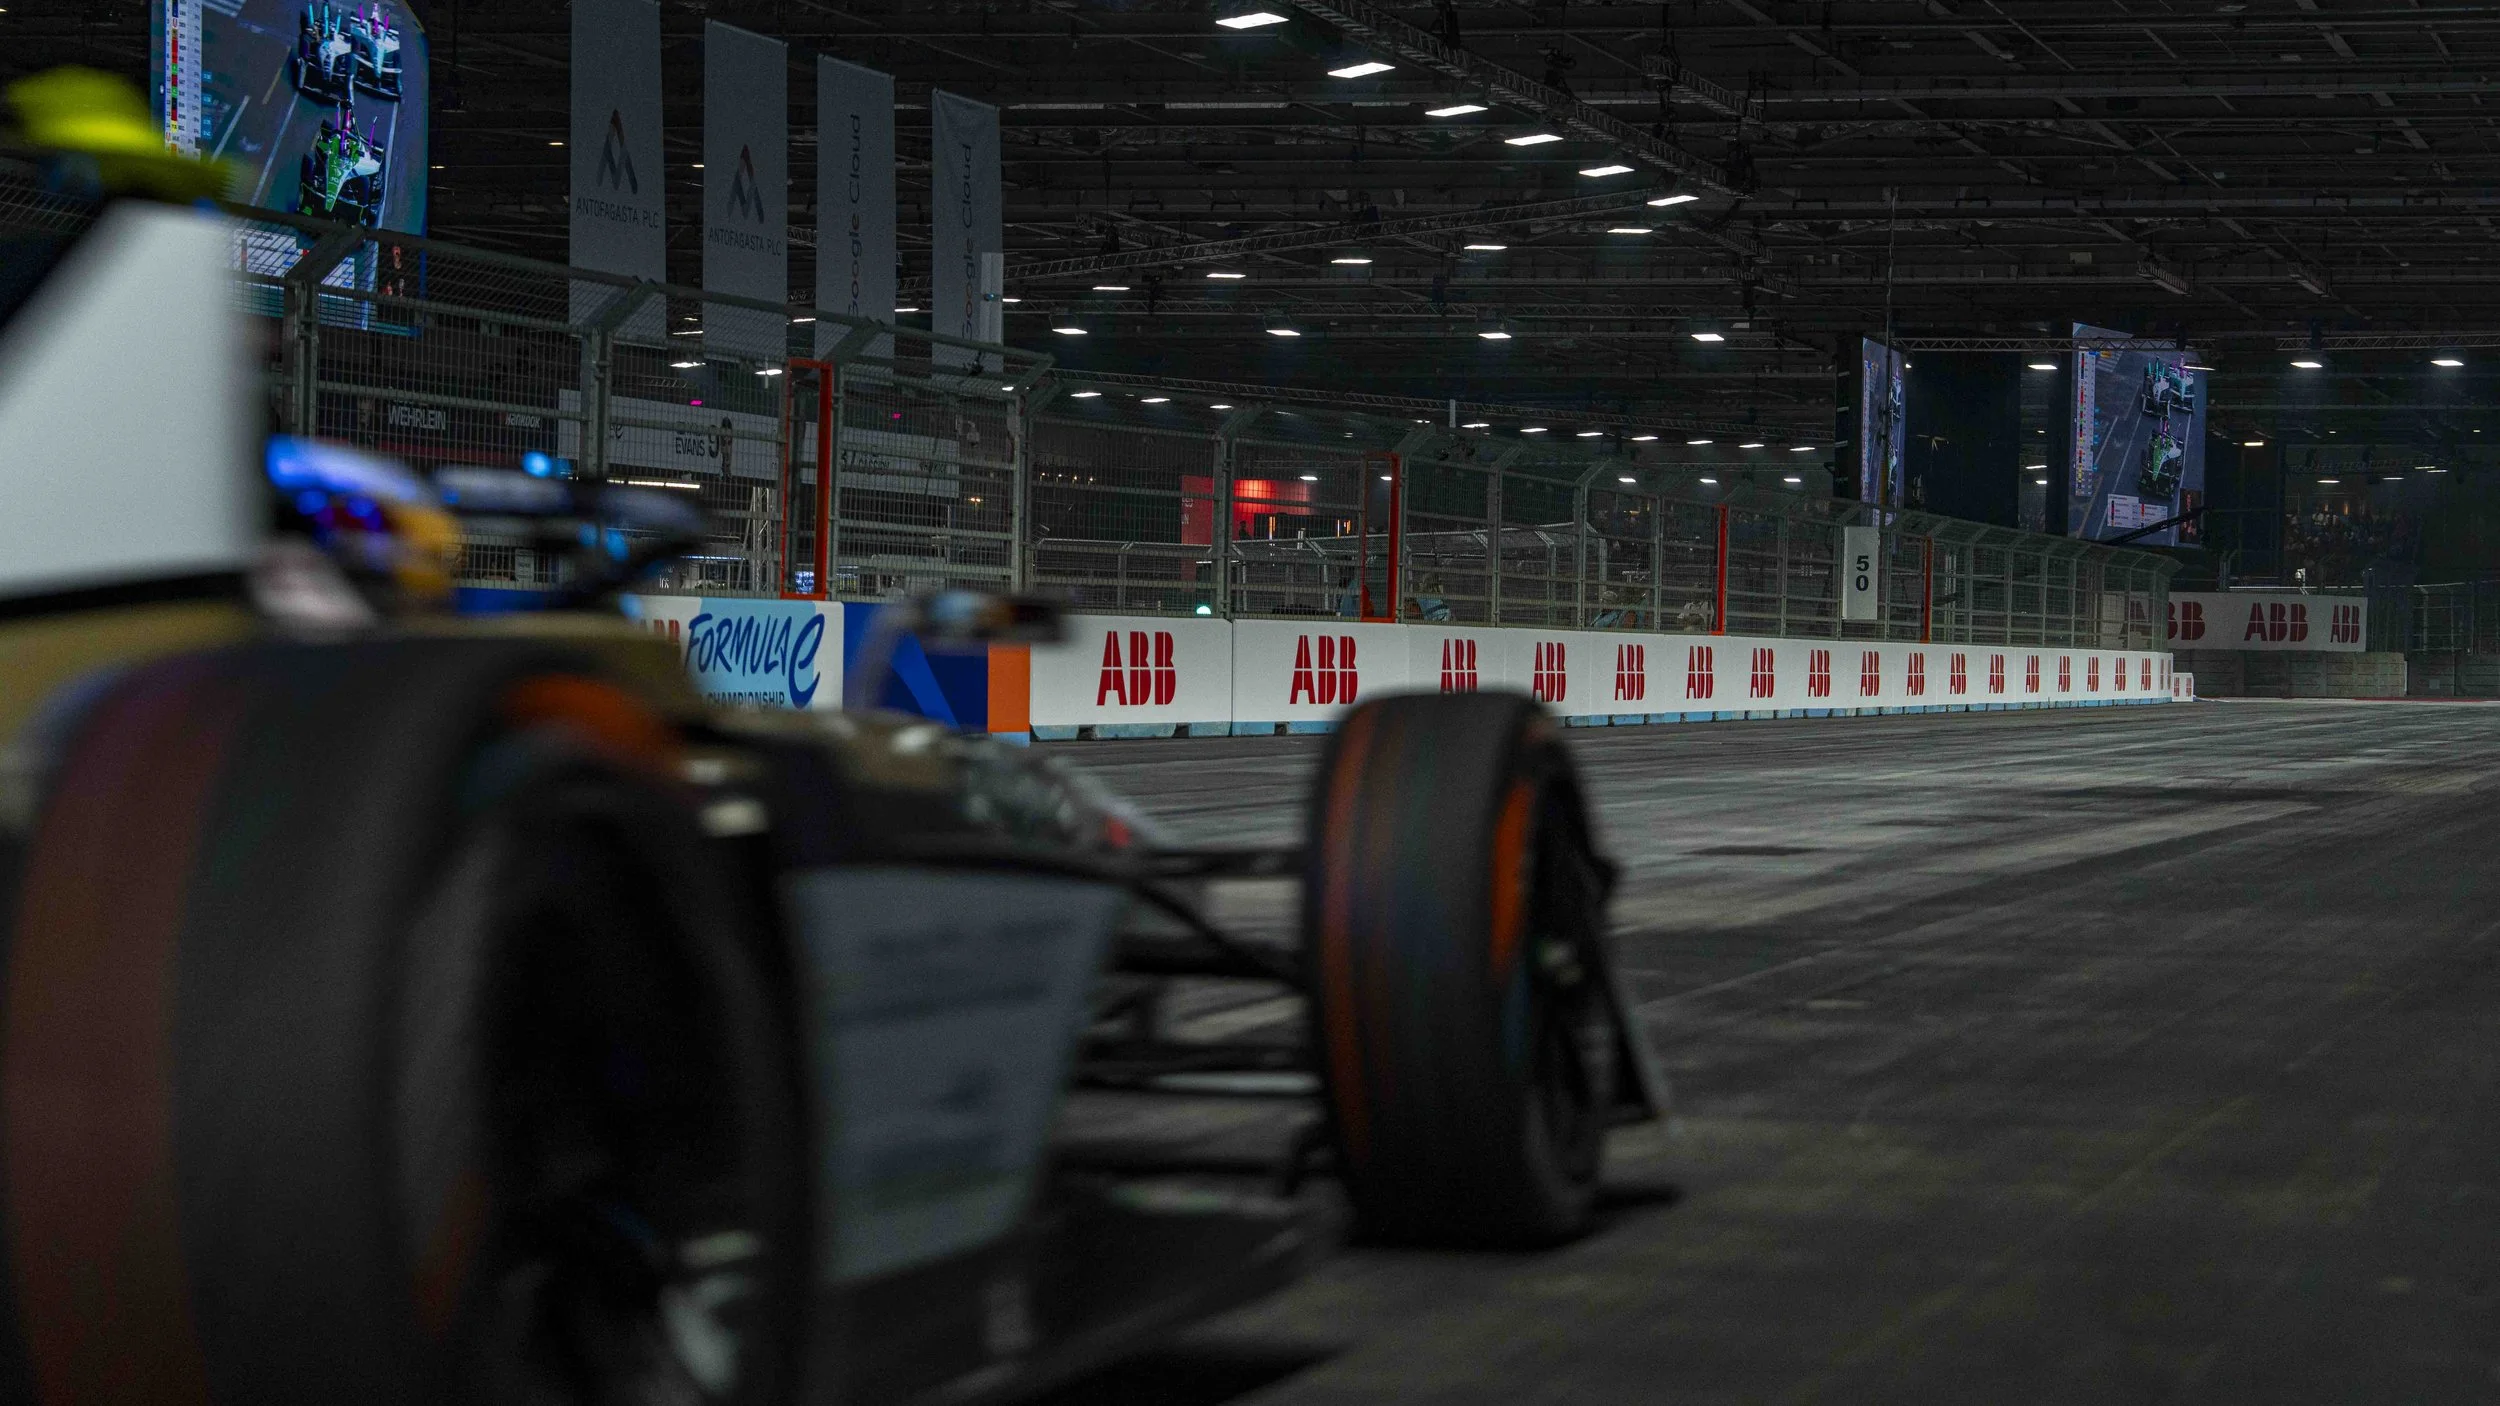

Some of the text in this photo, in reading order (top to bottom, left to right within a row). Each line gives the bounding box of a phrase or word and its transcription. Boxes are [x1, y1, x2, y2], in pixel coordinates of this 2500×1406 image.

[850, 114, 861, 204] Cloud
[962, 143, 972, 229] Cloud
[576, 198, 659, 228] ANTOFAGASTA PLC
[708, 227, 782, 256] ANTOFAGASTA PLC
[388, 405, 446, 430] WEHRLEIN
[675, 437, 705, 457] EVANS
[2244, 603, 2308, 642] ABB
[2331, 605, 2359, 643] ABB
[1096, 631, 1176, 706] ABB
[1290, 635, 1358, 704] ABB
[1440, 638, 1478, 695] ABB
[1532, 642, 1567, 703] ABB
[1614, 644, 1646, 701] ABB
[1686, 646, 1714, 699] ABB
[1750, 647, 1775, 698] ABB
[1808, 649, 1831, 697] ABB
[1860, 651, 1880, 696] ABB
[1907, 652, 1925, 696] ABB
[1949, 653, 1967, 695] ABB
[1989, 654, 2005, 694] ABB
[2025, 655, 2041, 693] ABB
